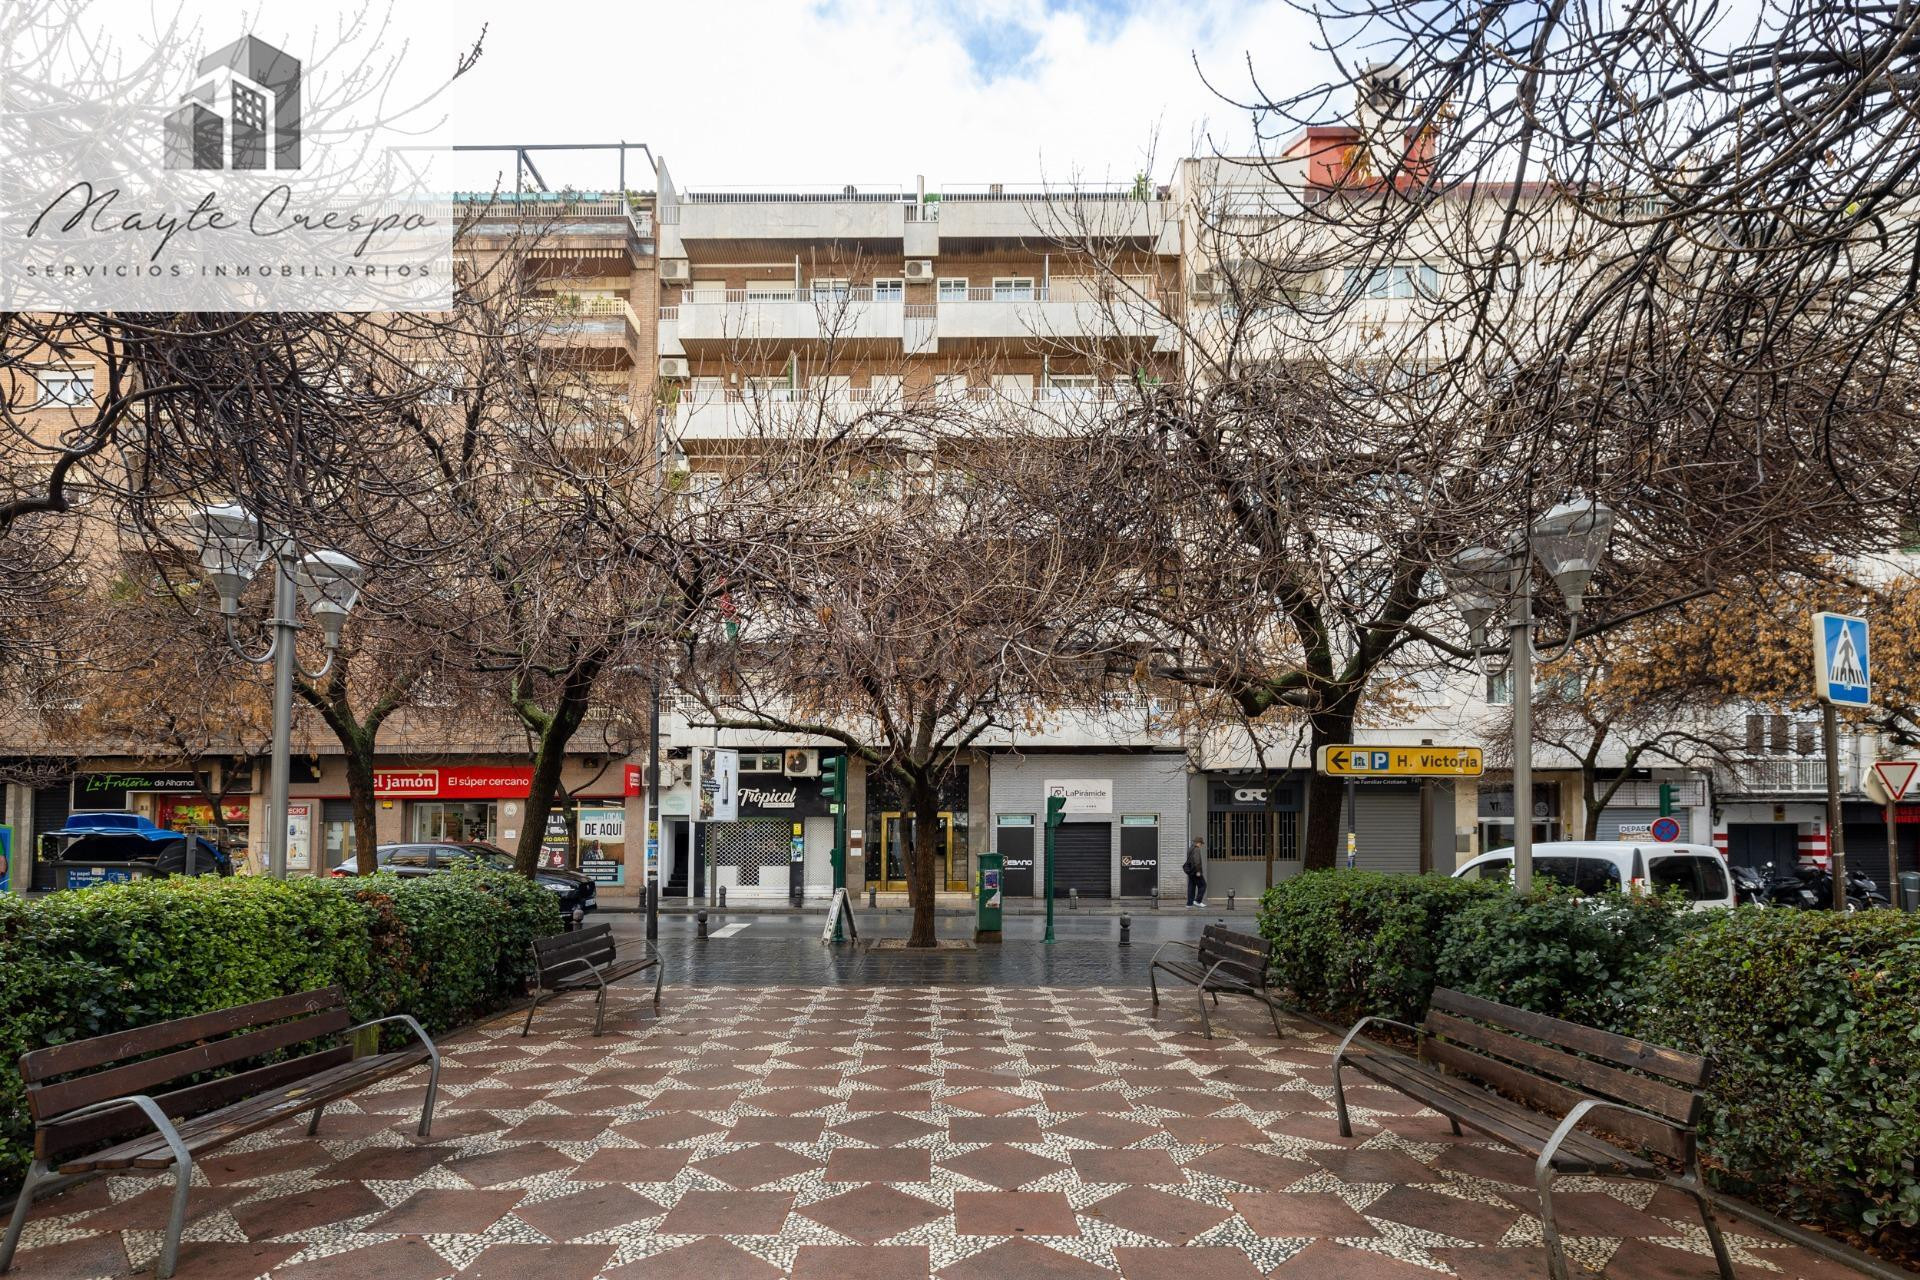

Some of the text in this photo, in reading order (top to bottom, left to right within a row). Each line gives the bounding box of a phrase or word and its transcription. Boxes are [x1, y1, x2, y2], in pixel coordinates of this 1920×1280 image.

[1374, 753, 1387, 769] P
[1397, 755, 1412, 768] H.
[154, 779, 165, 787] de
[385, 773, 434, 791] jamón
[448, 775, 529, 788] El súper cercano
[737, 787, 797, 807] Tropical
[584, 821, 622, 836] DE AQUÍ
